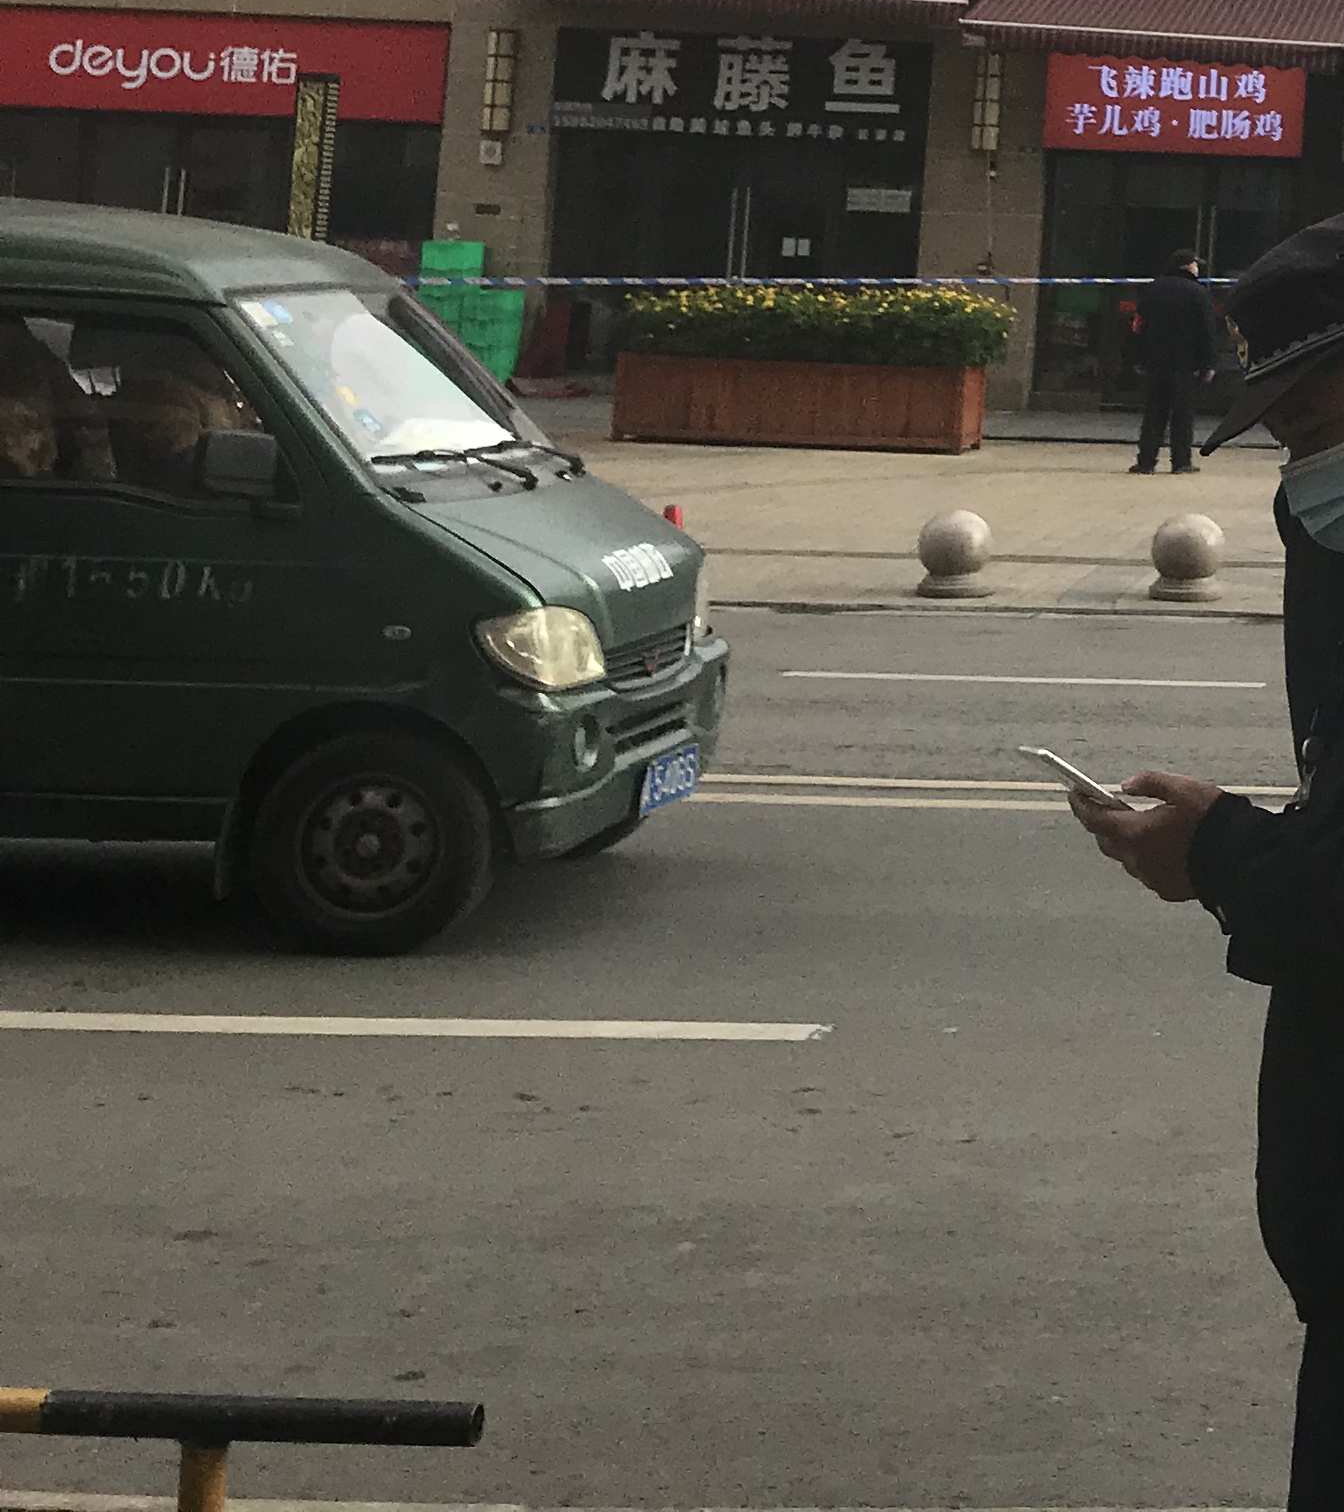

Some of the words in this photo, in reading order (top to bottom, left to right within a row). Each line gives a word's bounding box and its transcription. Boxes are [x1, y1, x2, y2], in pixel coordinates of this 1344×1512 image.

[48, 39, 216, 89] deyou
[219, 45, 298, 85] 德佑
[1088, 65, 1267, 104] 飞辣跑山鸡
